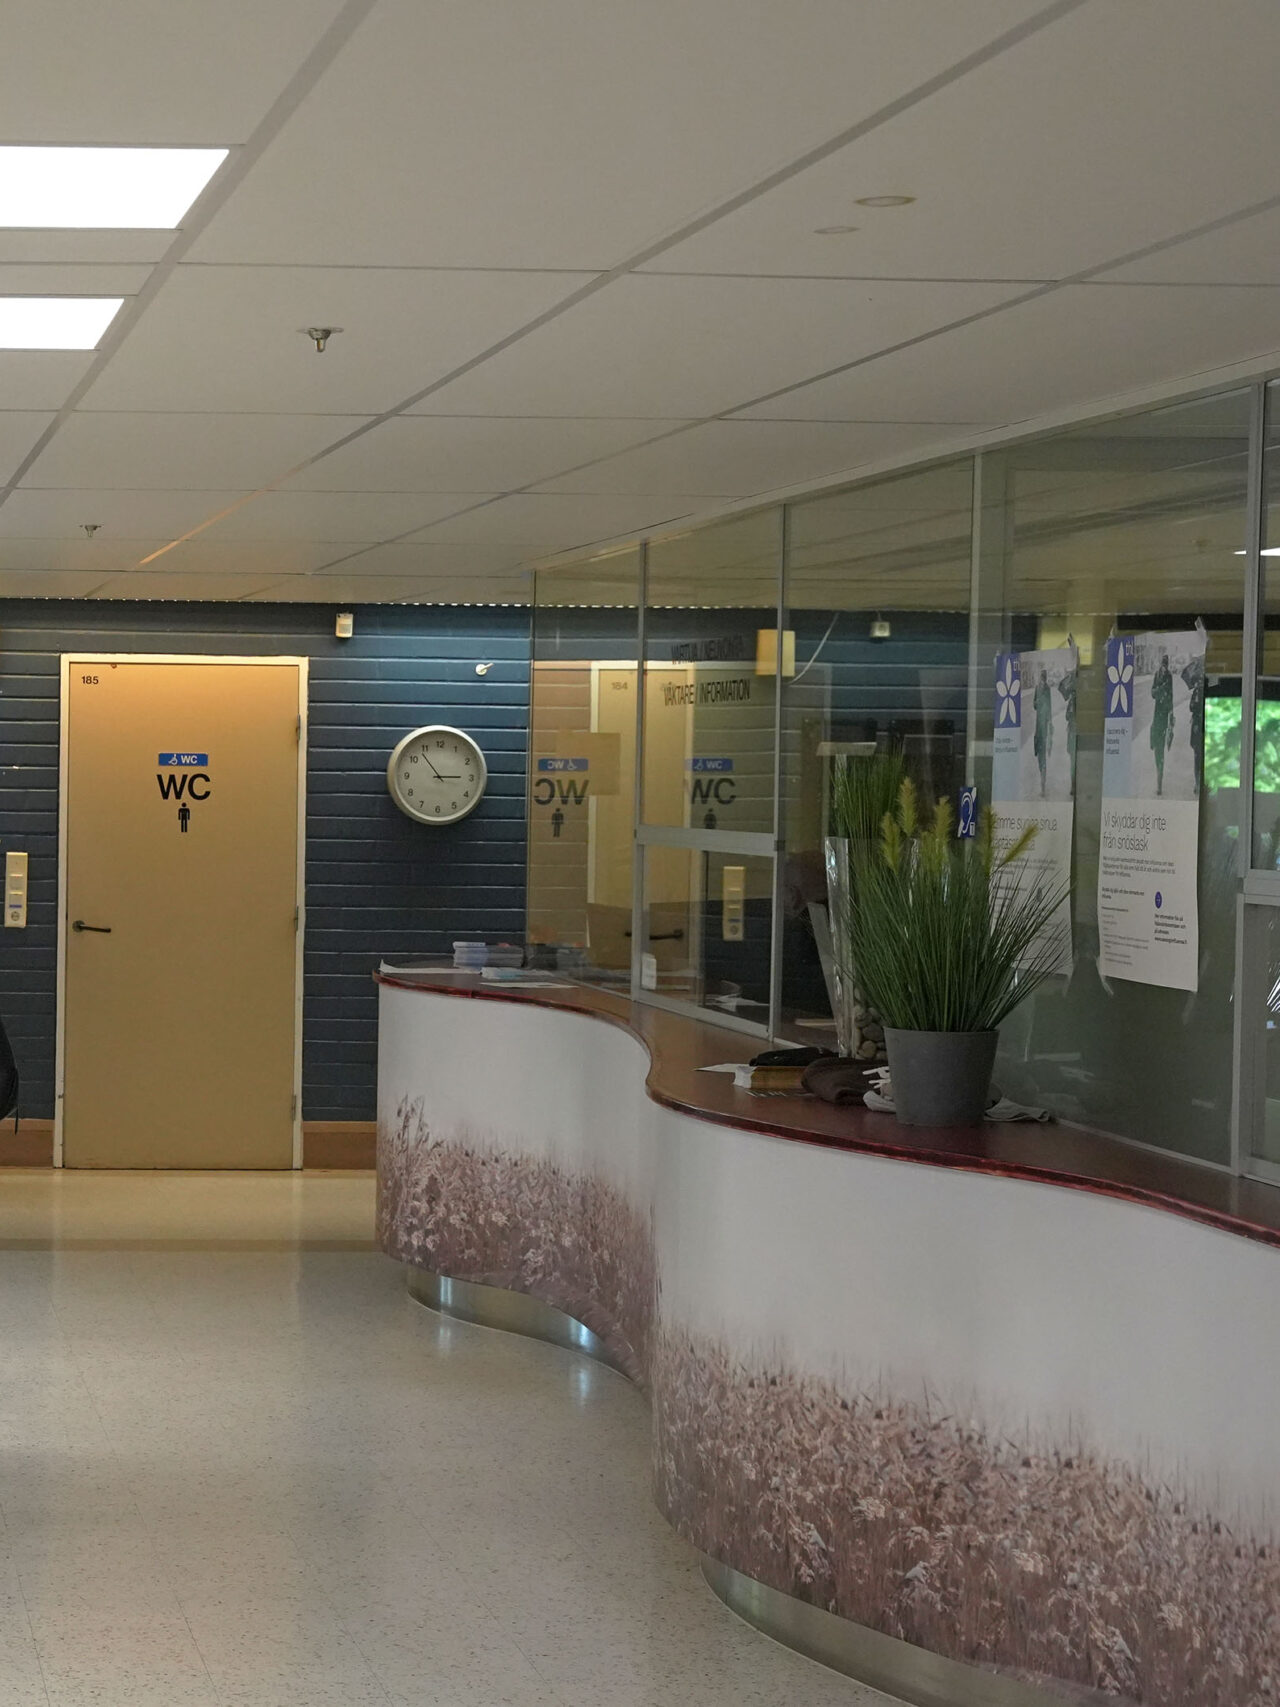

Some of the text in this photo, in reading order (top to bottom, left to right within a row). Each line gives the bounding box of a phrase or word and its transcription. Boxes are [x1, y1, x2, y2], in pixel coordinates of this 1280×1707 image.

[81, 675, 99, 685] 185
[700, 679, 750, 704] INFORMATION
[180, 755, 198, 764] WC
[706, 760, 722, 769] WC
[156, 773, 211, 801] WC
[687, 778, 736, 805] WC
[1139, 812, 1150, 834] dig
